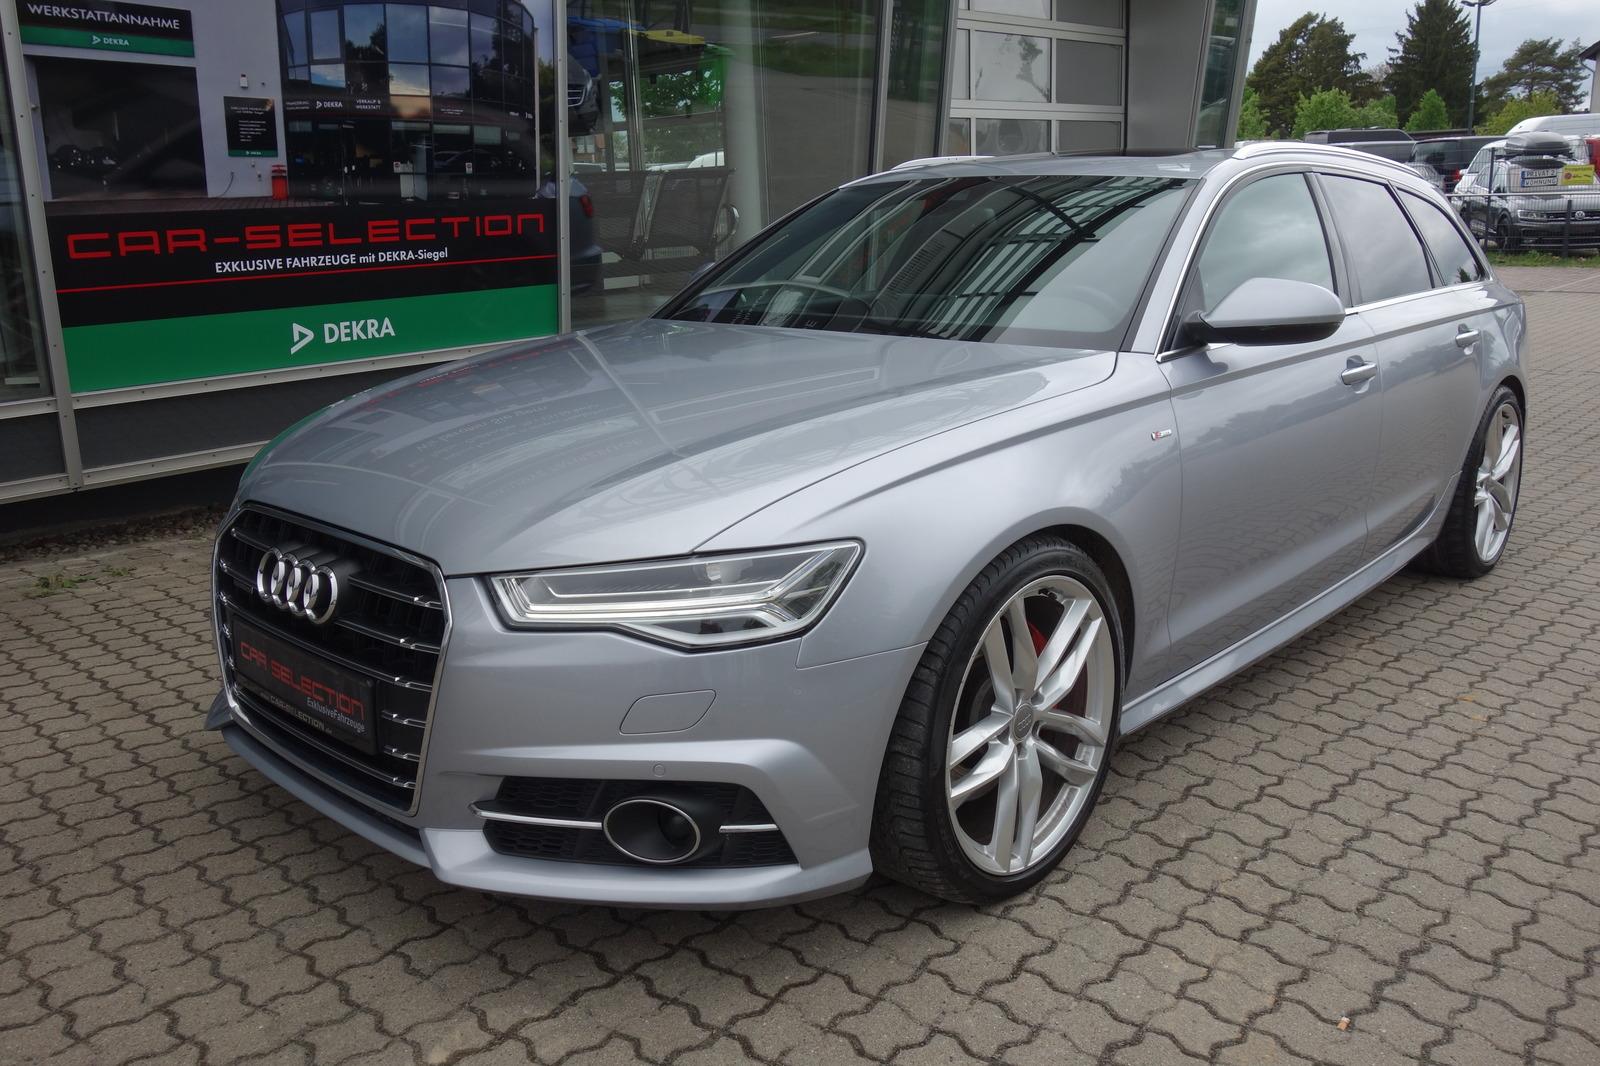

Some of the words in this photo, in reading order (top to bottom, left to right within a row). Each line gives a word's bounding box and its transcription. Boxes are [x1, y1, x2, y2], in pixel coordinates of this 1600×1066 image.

[26, 3, 180, 30] WERKSTATTANNAHME
[103, 37, 130, 46] DEKRA
[67, 213, 545, 260] CAR-SELECTION
[215, 257, 283, 273] EXKLUSIVE
[286, 253, 356, 269] FAHRZEUGE
[359, 251, 375, 264] mit
[378, 247, 448, 263] DEKRA-Siegel
[324, 317, 396, 344] DEKRA
[240, 642, 267, 671] CAR
[271, 659, 364, 720] SELECTION
